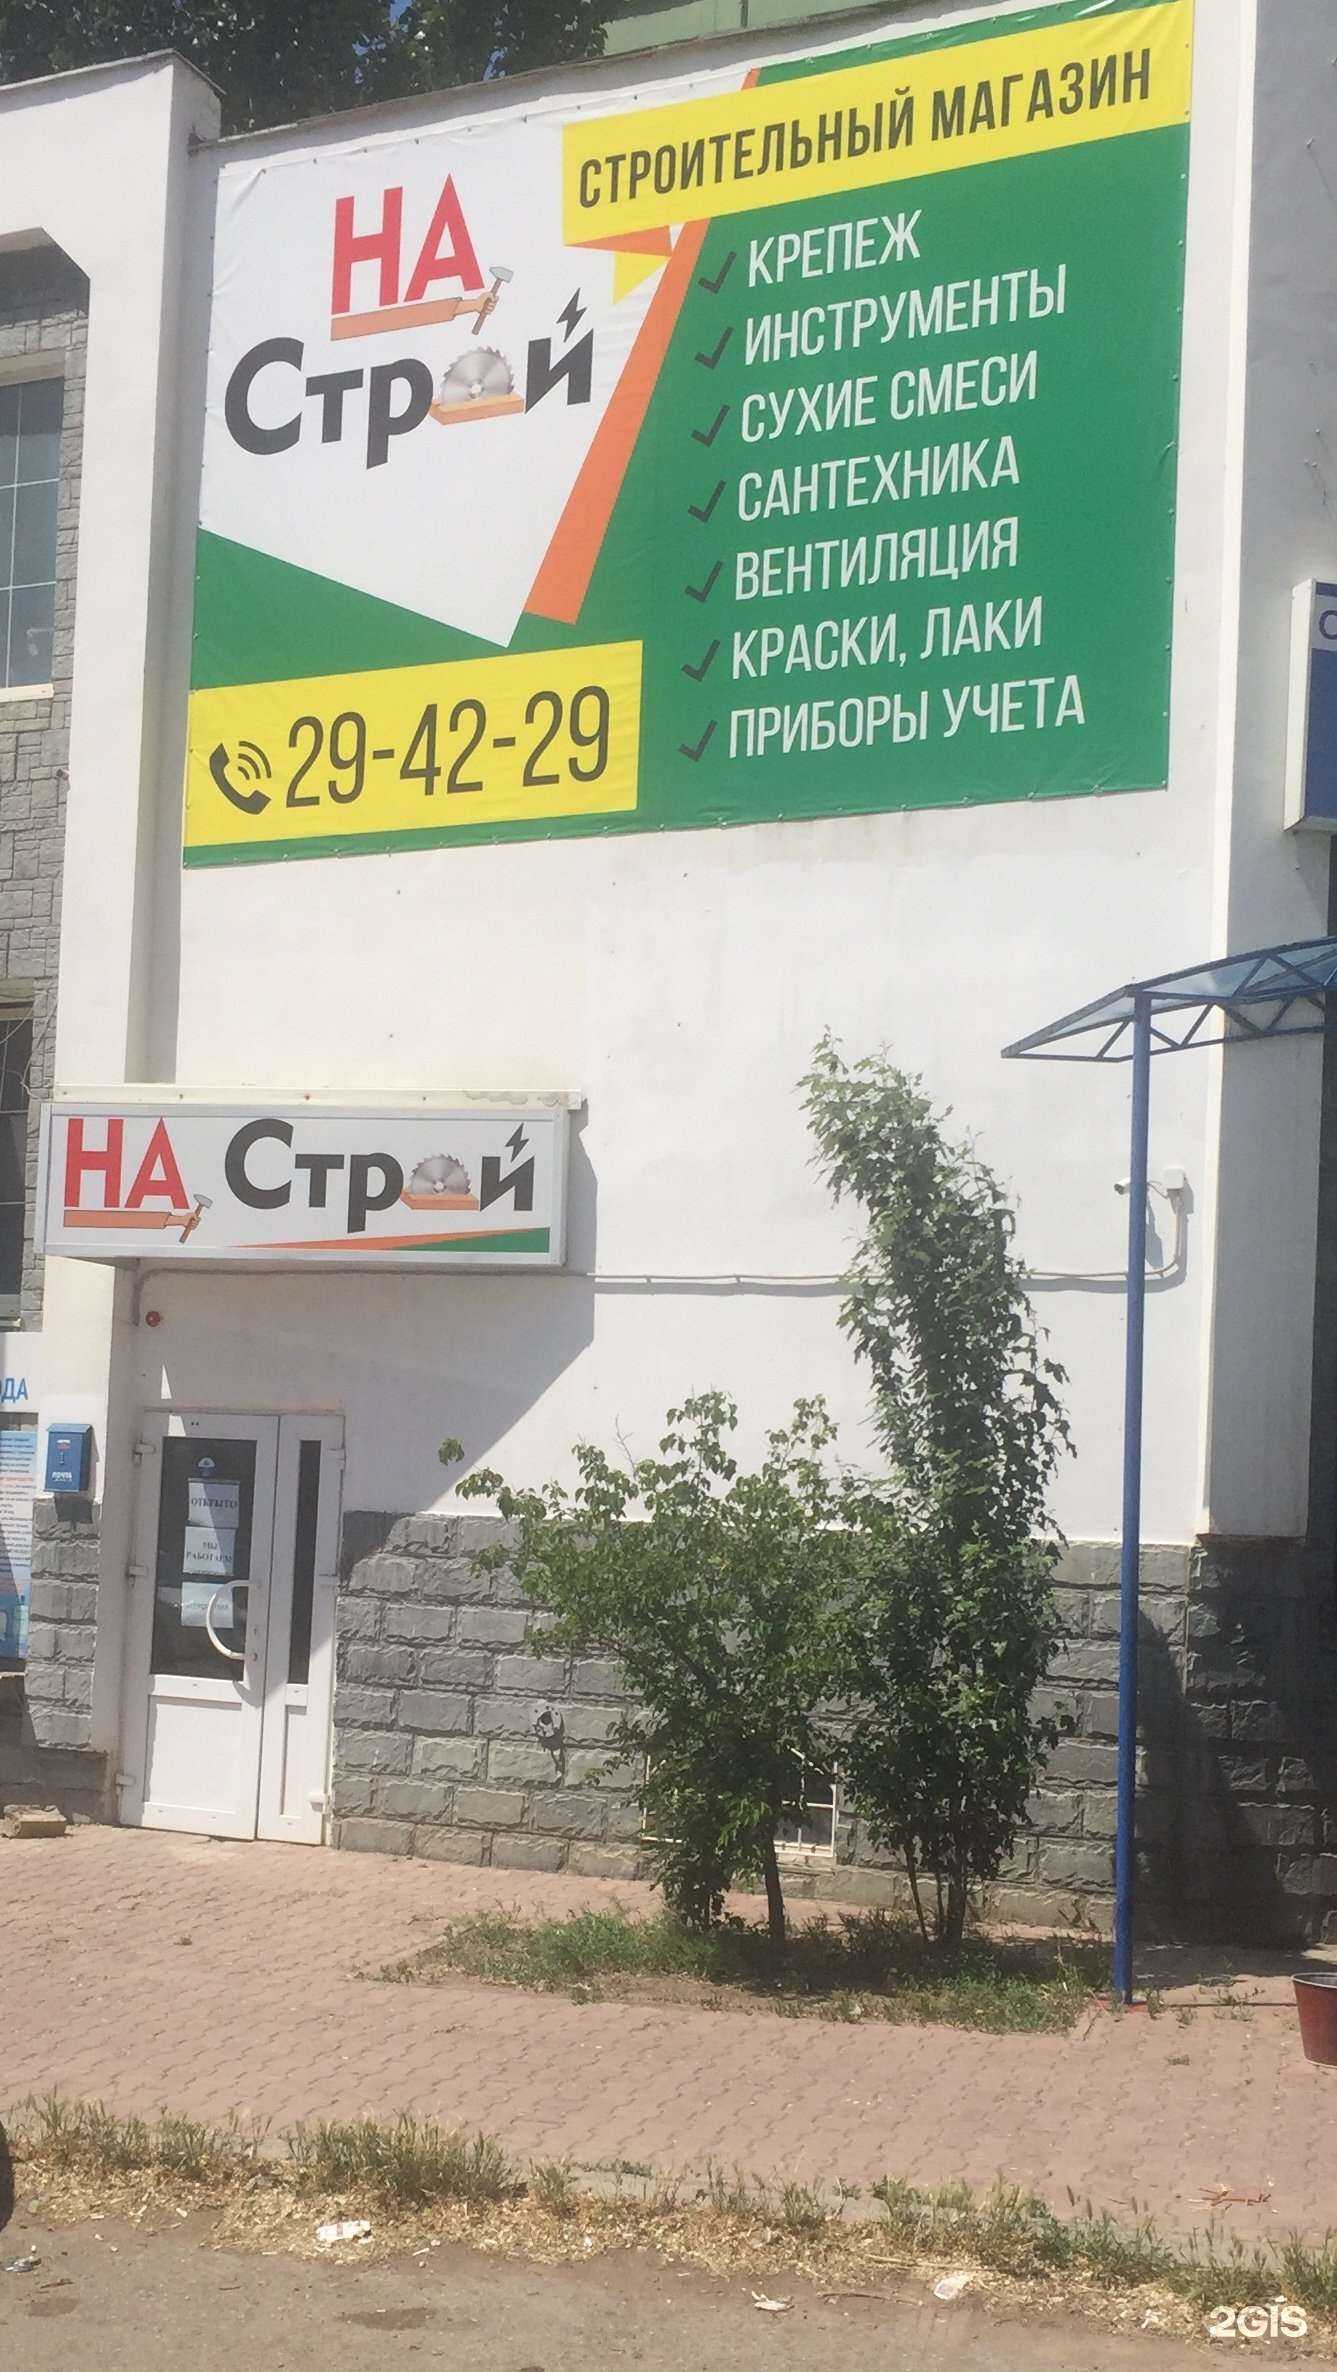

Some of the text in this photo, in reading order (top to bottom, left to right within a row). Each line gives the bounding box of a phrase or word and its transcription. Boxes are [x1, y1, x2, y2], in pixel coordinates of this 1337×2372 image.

[579, 48, 1151, 209] СТРОИТЕЛЬНЫЙ МАГАЗИН
[331, 173, 485, 315] НА
[747, 209, 922, 289] КРЕПЕЖ
[744, 264, 1068, 366] ИНСТРУМЕНТЫ
[741, 350, 1039, 444] СУХИЕ СМЕСИ
[737, 435, 1021, 522] САНТЕХНИКА
[734, 516, 1019, 600] ВЕНТИЛЯЦИЯ
[731, 595, 1044, 680] КРАСКИ, ЛАКИ
[285, 685, 610, 809] 29-42-29
[728, 674, 1087, 760] ПРИБОРЫ УЧЕТА
[63, 1116, 190, 1209] НА
[0, 1377, 29, 1403] ДА
